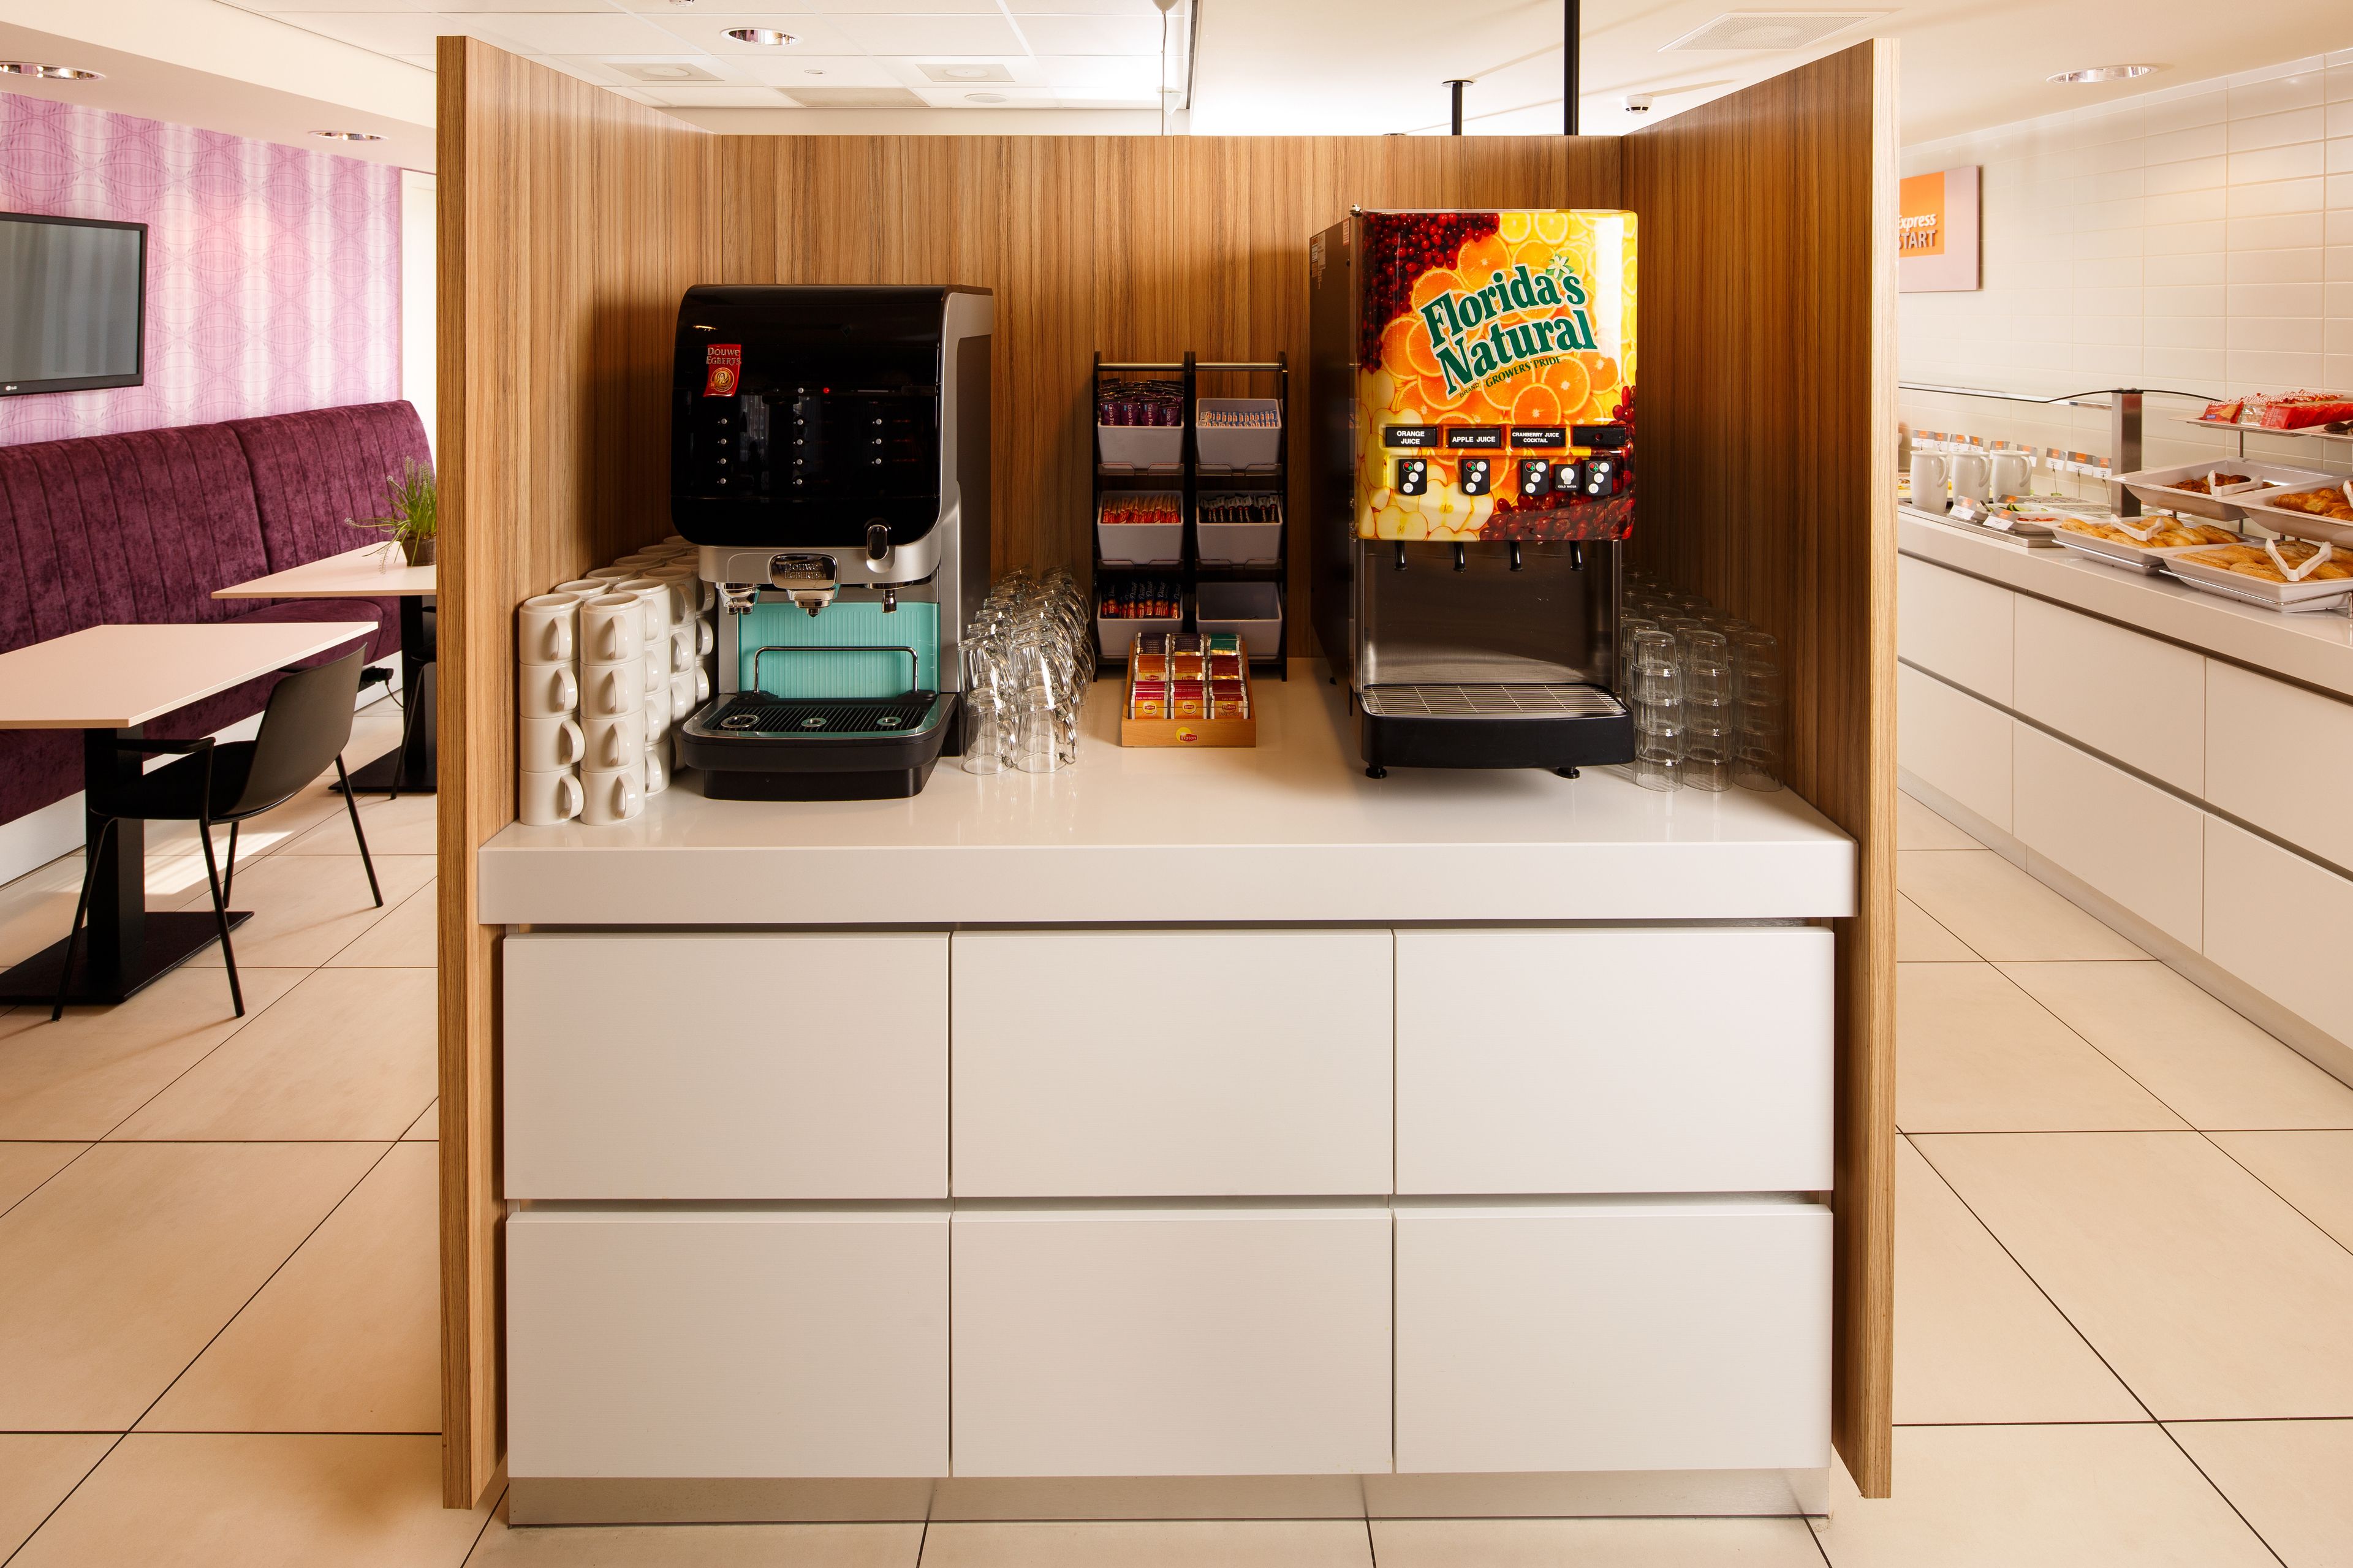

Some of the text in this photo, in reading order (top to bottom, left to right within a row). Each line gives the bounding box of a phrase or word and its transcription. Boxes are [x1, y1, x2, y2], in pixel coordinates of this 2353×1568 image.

[706, 356, 742, 366] EGBERTS
[1436, 309, 1598, 396] Natural
[1459, 382, 1480, 398] BRAND
[1534, 355, 1562, 369] PRIDE
